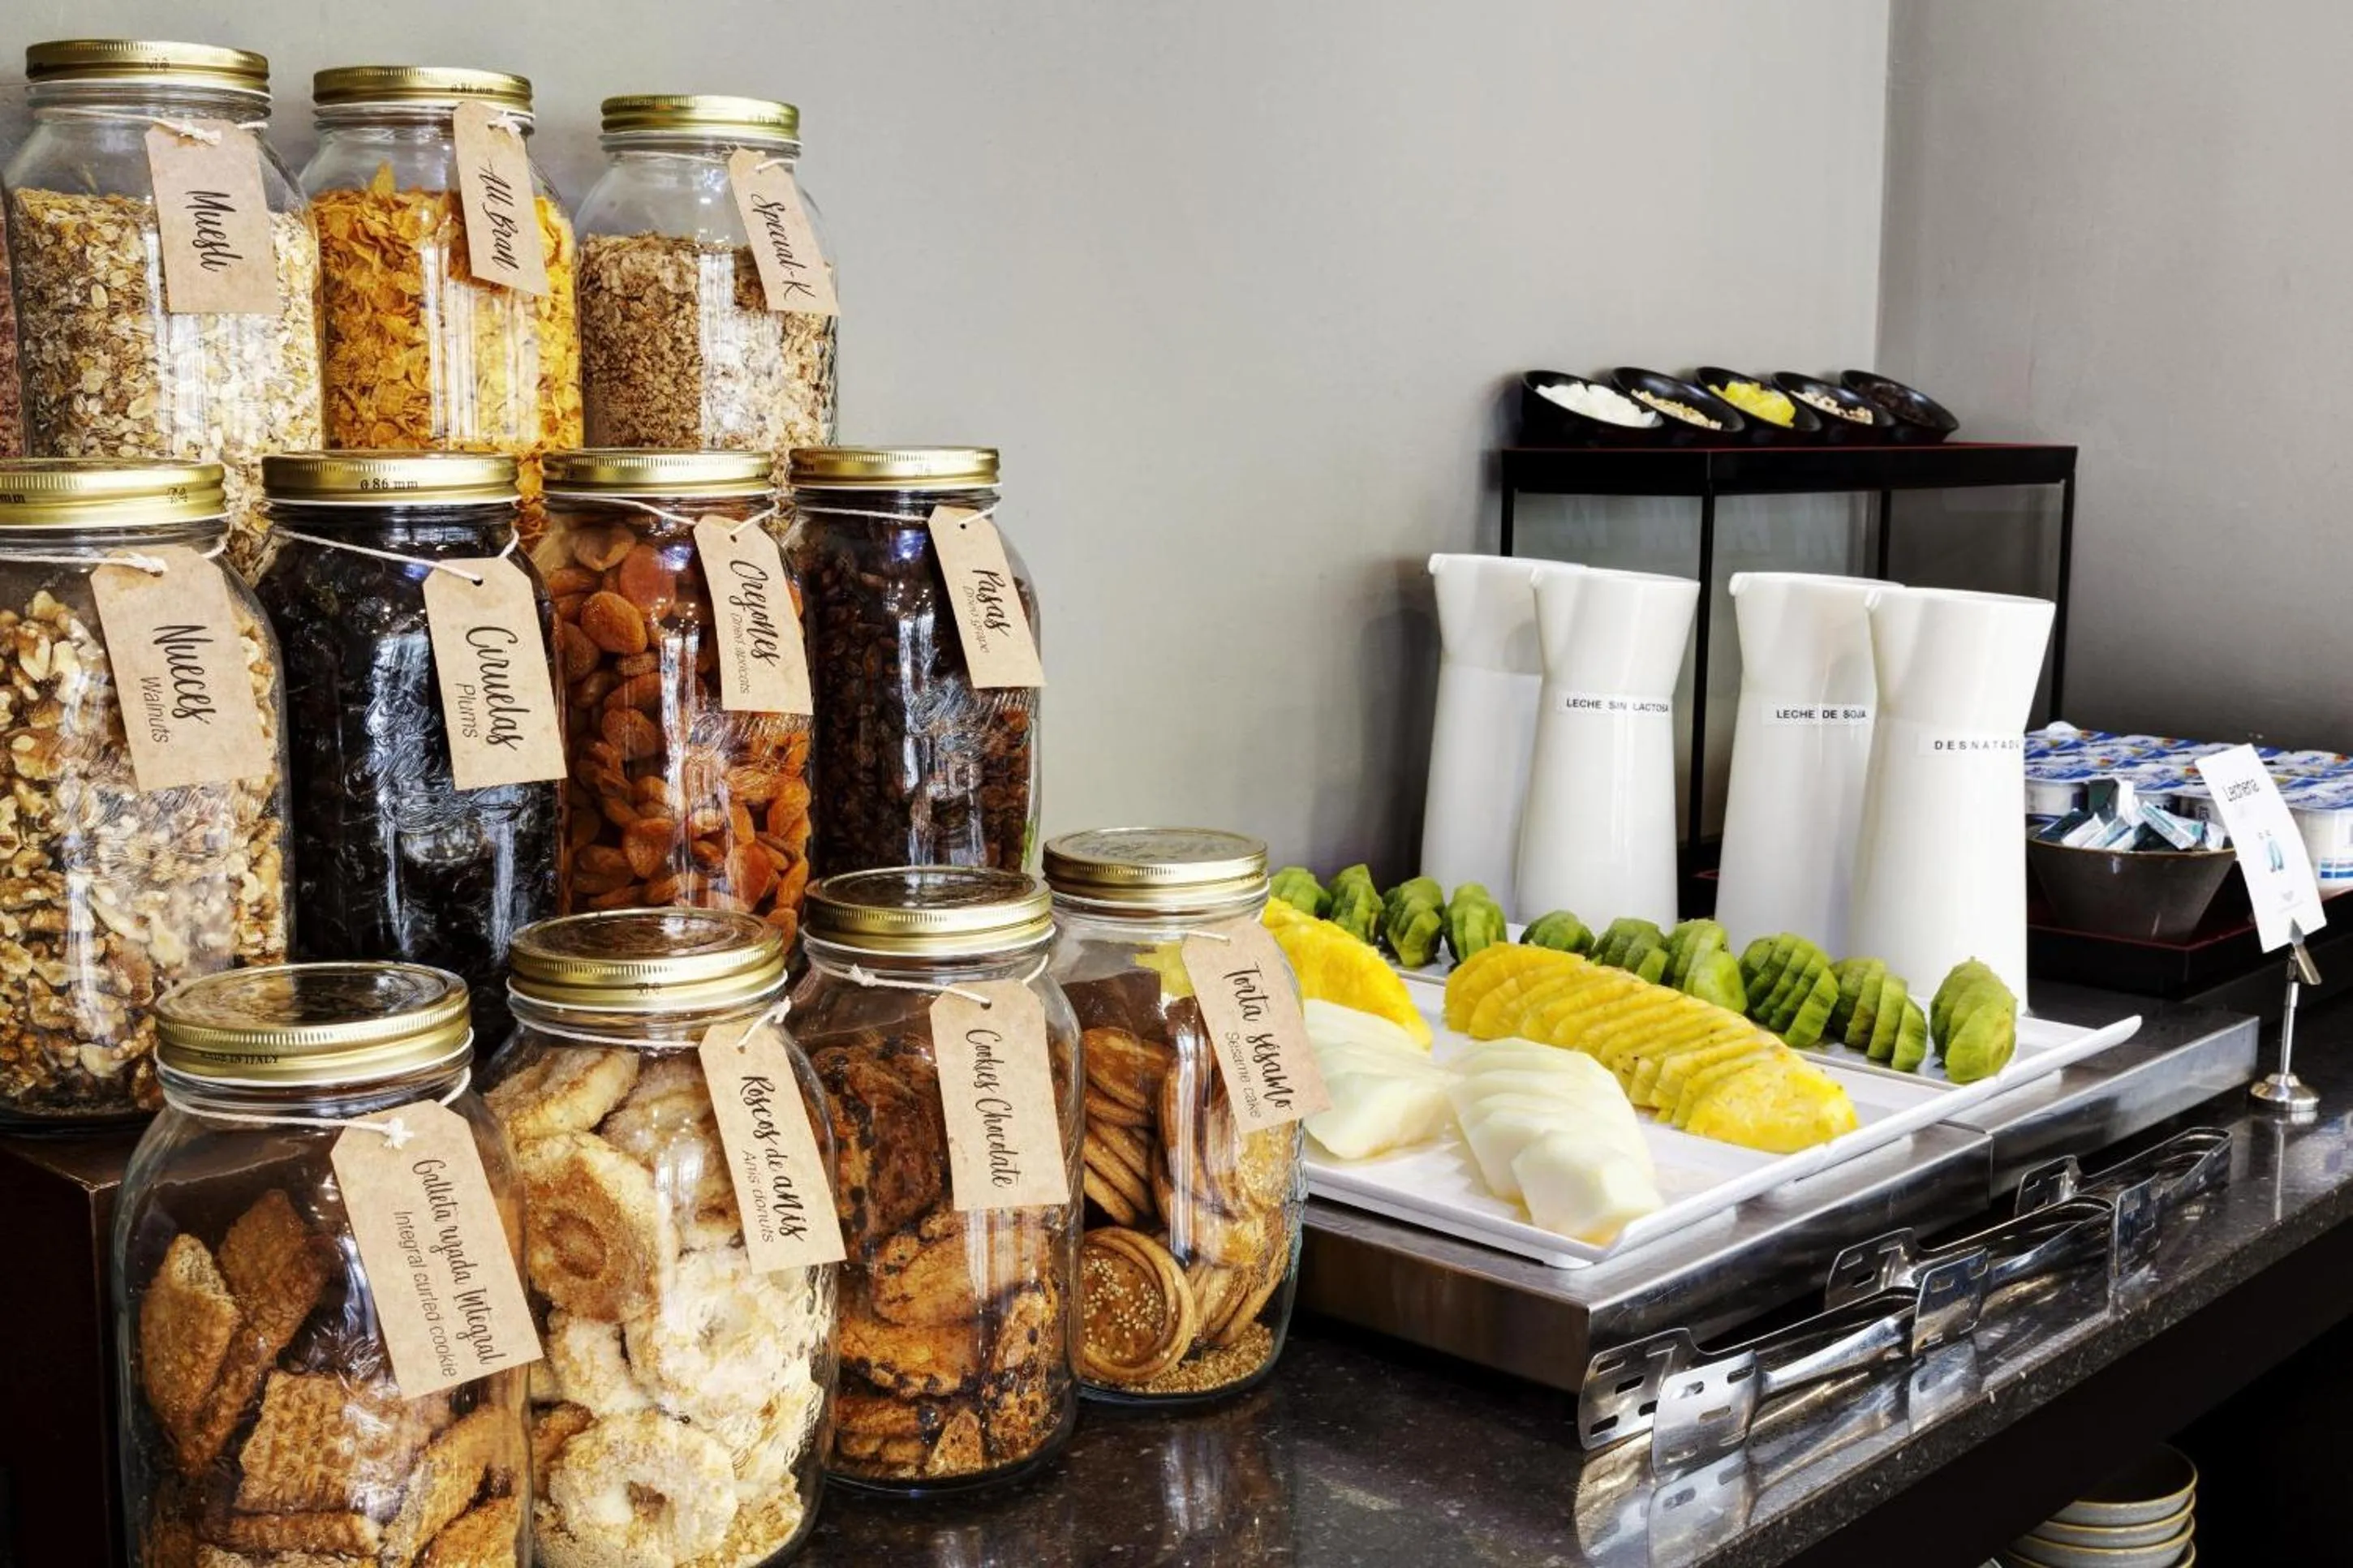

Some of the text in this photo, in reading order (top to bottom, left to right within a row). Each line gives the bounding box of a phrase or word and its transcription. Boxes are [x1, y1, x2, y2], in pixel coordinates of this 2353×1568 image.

[185, 191, 243, 273] Muesli
[478, 157, 520, 271] All Bran
[751, 193, 816, 301] Special-K
[372, 478, 389, 490] 86
[393, 480, 418, 490] mm
[729, 560, 781, 668] Orejones
[972, 569, 1012, 637] Pasas
[140, 676, 171, 743] Walnuts
[153, 625, 217, 725] Nueces
[454, 682, 477, 738] Plums
[466, 626, 531, 751] Ciruelas
[1566, 698, 1602, 710] LECHE
[1608, 700, 1628, 711] SIN
[1776, 709, 1867, 720] LECHE DE SOJA
[1222, 960, 1271, 1023] Torta
[245, 1054, 279, 1065] ITALY
[1225, 1031, 1251, 1084] Sesame
[740, 1076, 781, 1148] Roscos
[765, 1147, 789, 1171] de
[966, 1029, 1022, 1188] Cookies Chocolate
[742, 1149, 774, 1244] Anis donuts
[393, 1210, 458, 1378] Integral curled cookie
[411, 1158, 458, 1222] Galleta
[453, 1287, 508, 1366] Integral
